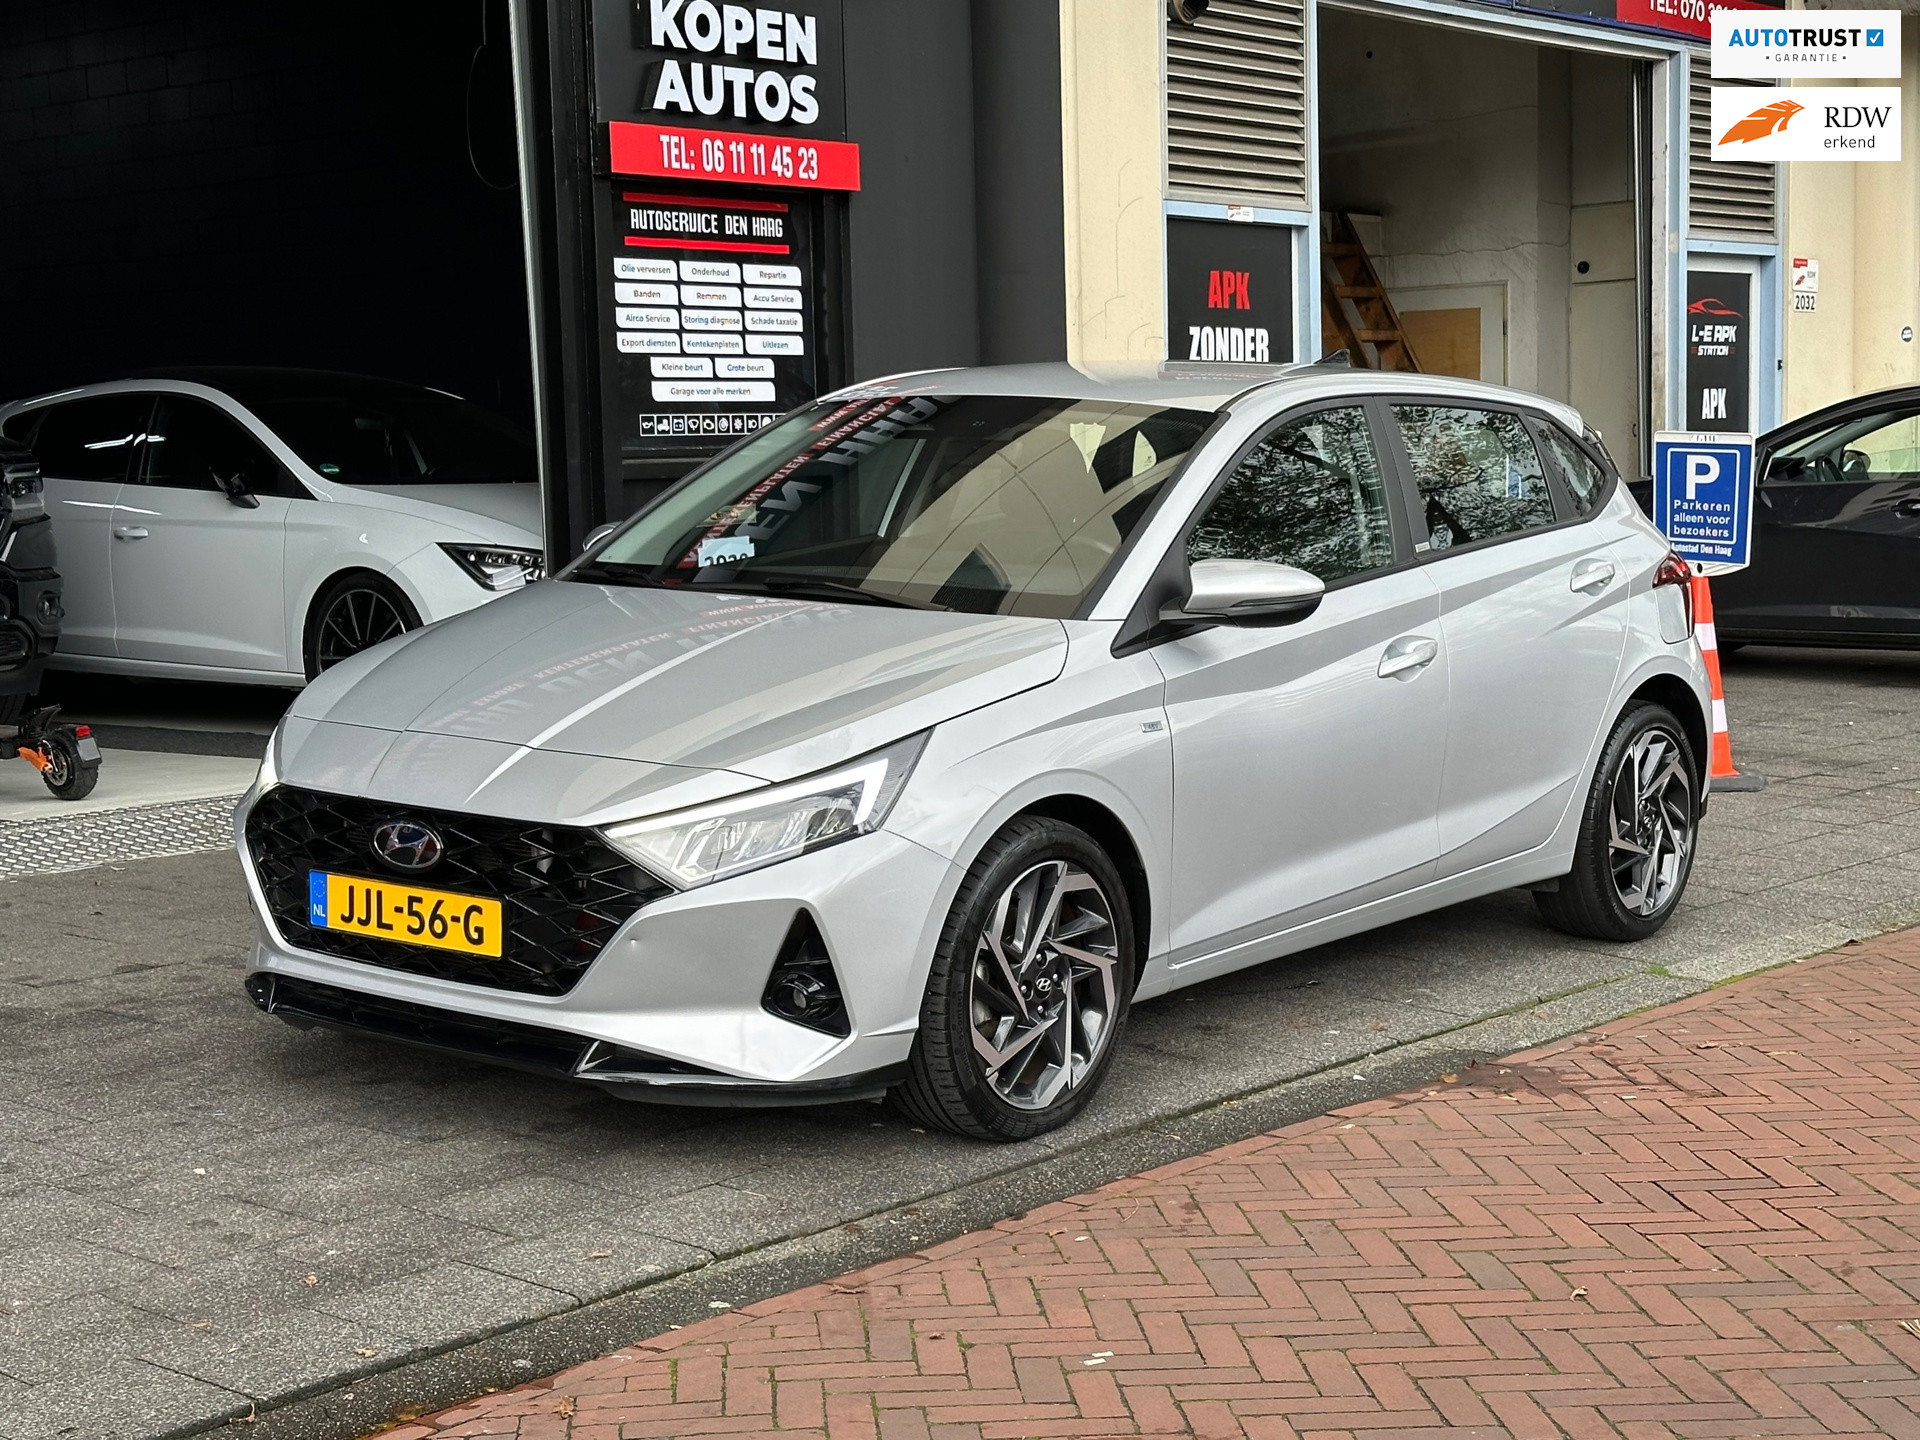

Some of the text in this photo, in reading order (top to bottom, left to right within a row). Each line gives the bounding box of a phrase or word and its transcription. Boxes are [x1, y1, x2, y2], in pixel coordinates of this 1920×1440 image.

[1680, 0, 1706, 22] 070
[650, 0, 818, 65] KOPEN
[652, 59, 820, 124] AUTOS
[659, 134, 819, 181] TEL: 06 11 11 45 23
[630, 208, 784, 239] AUTOSERVICE DEN HAAG
[621, 264, 672, 275] Olie verversen
[691, 267, 730, 277] Onderhoud
[633, 289, 661, 299] Banden
[1207, 269, 1251, 310] APK
[696, 292, 727, 301] Remmen
[753, 294, 795, 304] Accu Service
[1795, 295, 1816, 310] 2032
[625, 313, 671, 323] Airco Service
[683, 315, 741, 326] Storing diagnose
[751, 316, 799, 326] Schade taxatie
[1713, 325, 1738, 343] APK
[621, 338, 677, 349] Export diensten
[686, 339, 740, 350] Kentekenplaten
[762, 341, 789, 350] Uitlezen
[1188, 326, 1270, 362] ZONDER
[1697, 345, 1730, 356] STATION
[661, 362, 704, 372] Kleine beurt
[727, 363, 765, 372] Grote beurt
[670, 387, 751, 397] Garage voor alle merken
[1701, 387, 1727, 420] APK
[1685, 454, 1721, 500] P
[1673, 500, 1731, 512] Parkeren
[1673, 512, 1731, 525] alleen voor
[1673, 525, 1730, 538] bezoekers
[1700, 544, 1713, 554] Den
[1714, 545, 1733, 557] Haag
[313, 903, 326, 918] NL
[340, 885, 485, 946] JJL-56-G
